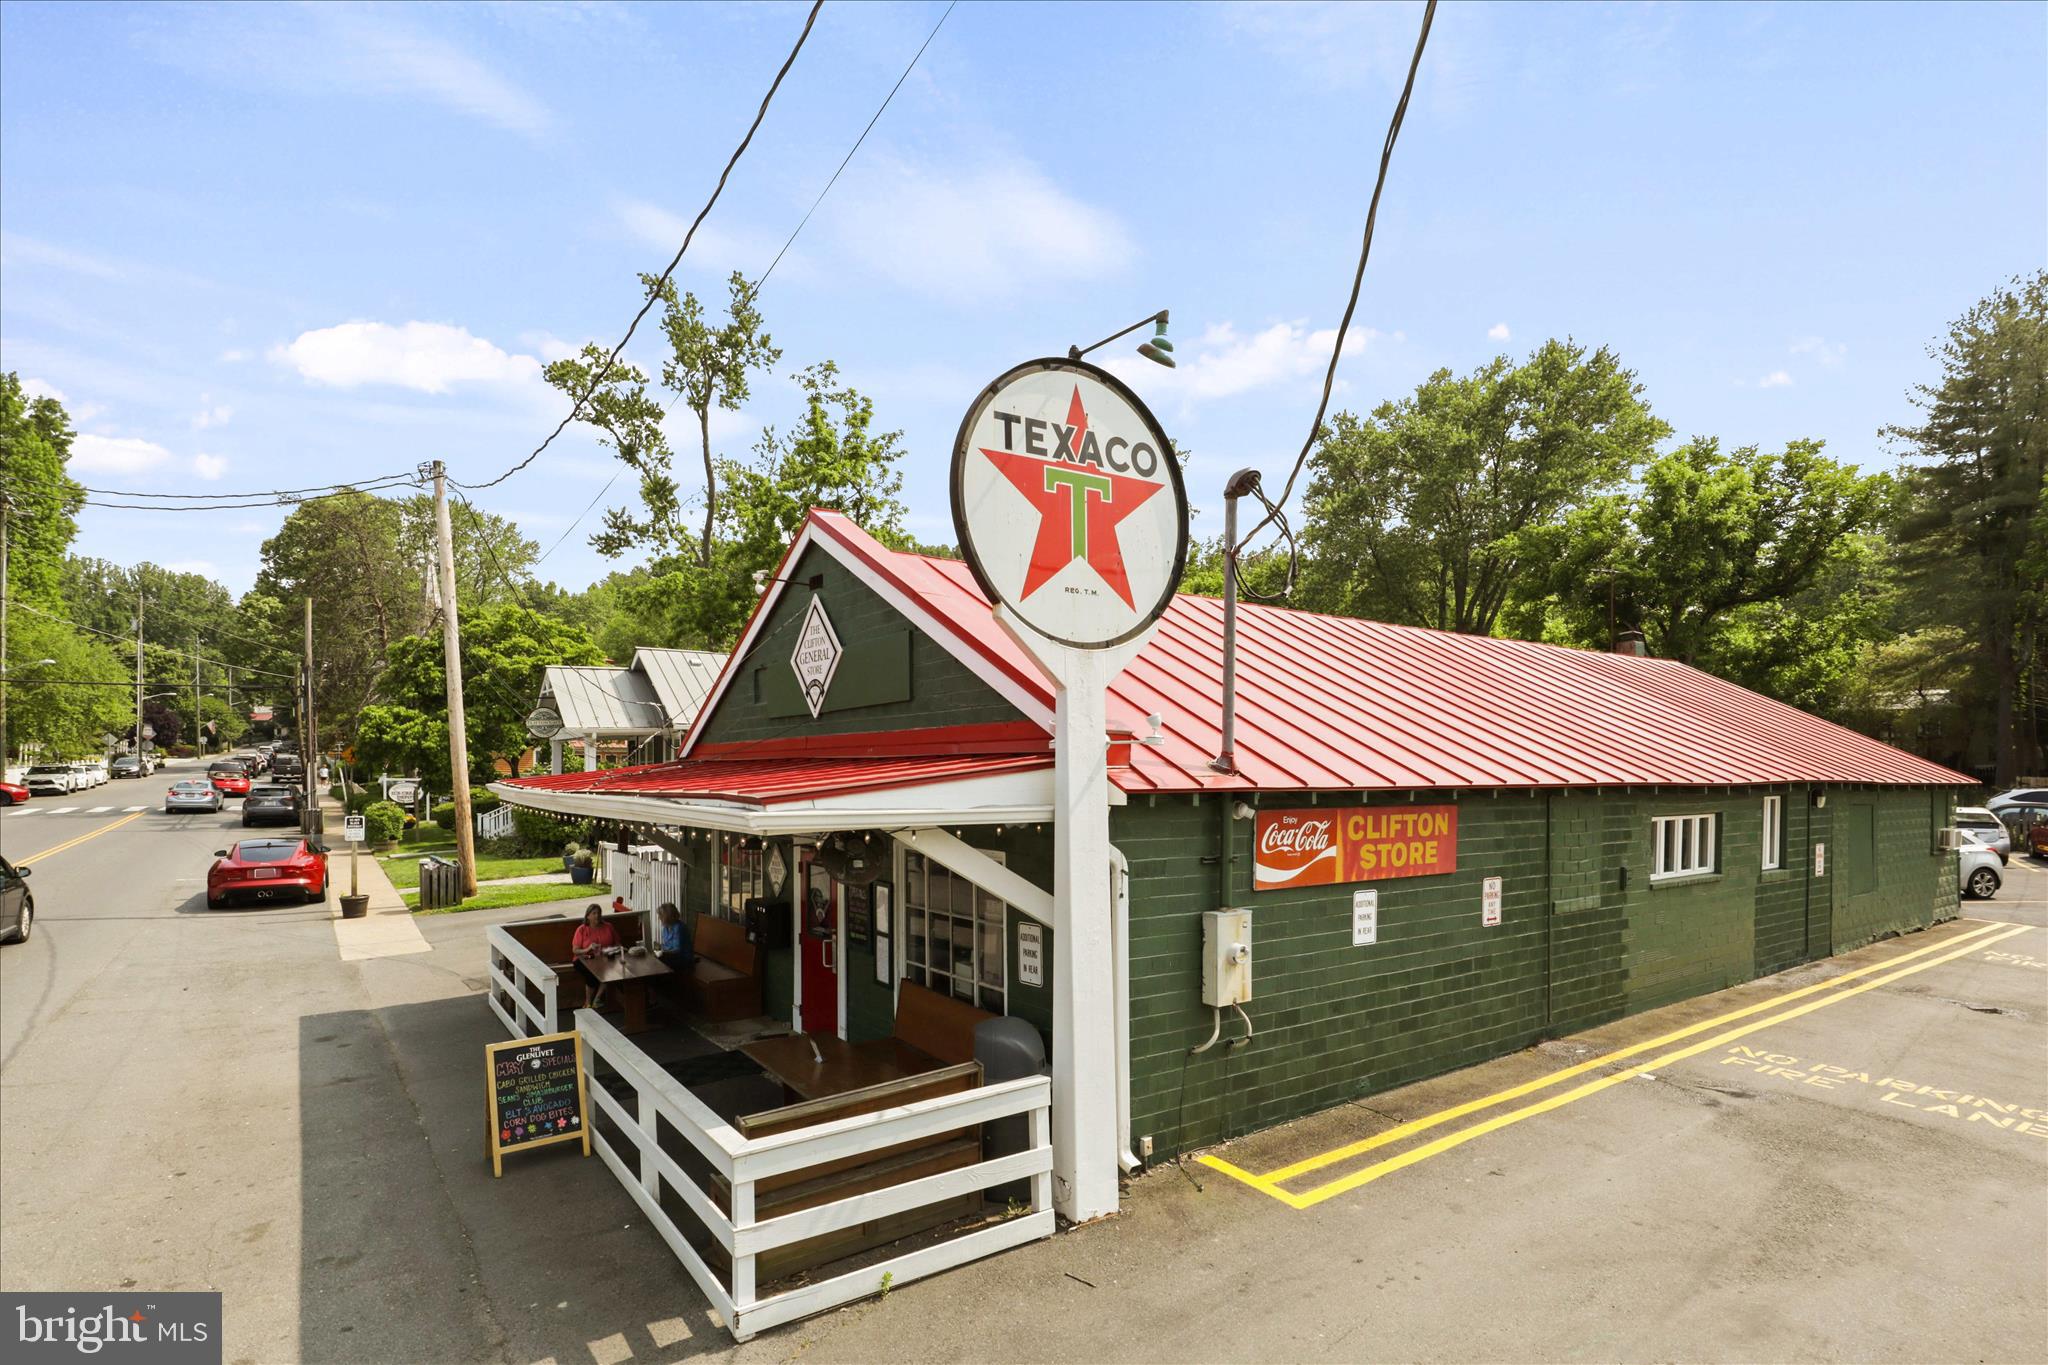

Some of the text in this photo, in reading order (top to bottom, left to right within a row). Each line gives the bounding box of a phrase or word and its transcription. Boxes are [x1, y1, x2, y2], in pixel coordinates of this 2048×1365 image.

[993, 410, 1158, 478] TEXACO
[1045, 466, 1112, 561] T
[1064, 586, 1100, 597] REG. T.M.
[810, 624, 820, 636] THE
[803, 636, 826, 650] CLIFTON
[799, 648, 830, 665] GENERAL
[807, 665, 822, 676] STORE
[1282, 815, 1298, 825] Enjoy
[1348, 812, 1449, 841] CLIFTON
[1261, 820, 1332, 854] Coca-Cola
[1359, 840, 1438, 870] STORE
[1489, 880, 1497, 890] NO
[1357, 913, 1373, 921] PARKING
[1020, 932, 1040, 944] ADDITIONAL
[1022, 947, 1038, 959] PARKING
[1984, 951, 2035, 961] NO
[1023, 963, 1038, 975] IN REAR
[516, 1048, 554, 1062] GLENLIVET
[496, 1054, 576, 1076] MAY SPECIALS
[519, 1073, 546, 1085] GRILLED
[549, 1067, 576, 1079] CHICKEN
[515, 1081, 550, 1094] SANDWICH
[1728, 1045, 2048, 1122] NO PARKING
[523, 1097, 544, 1107] CLUB
[1720, 1056, 2048, 1139] FIRE LANE
[505, 1108, 522, 1119] BLT
[533, 1098, 571, 1114] AVOCADO
[504, 1106, 574, 1129] CORN DOG BITES
